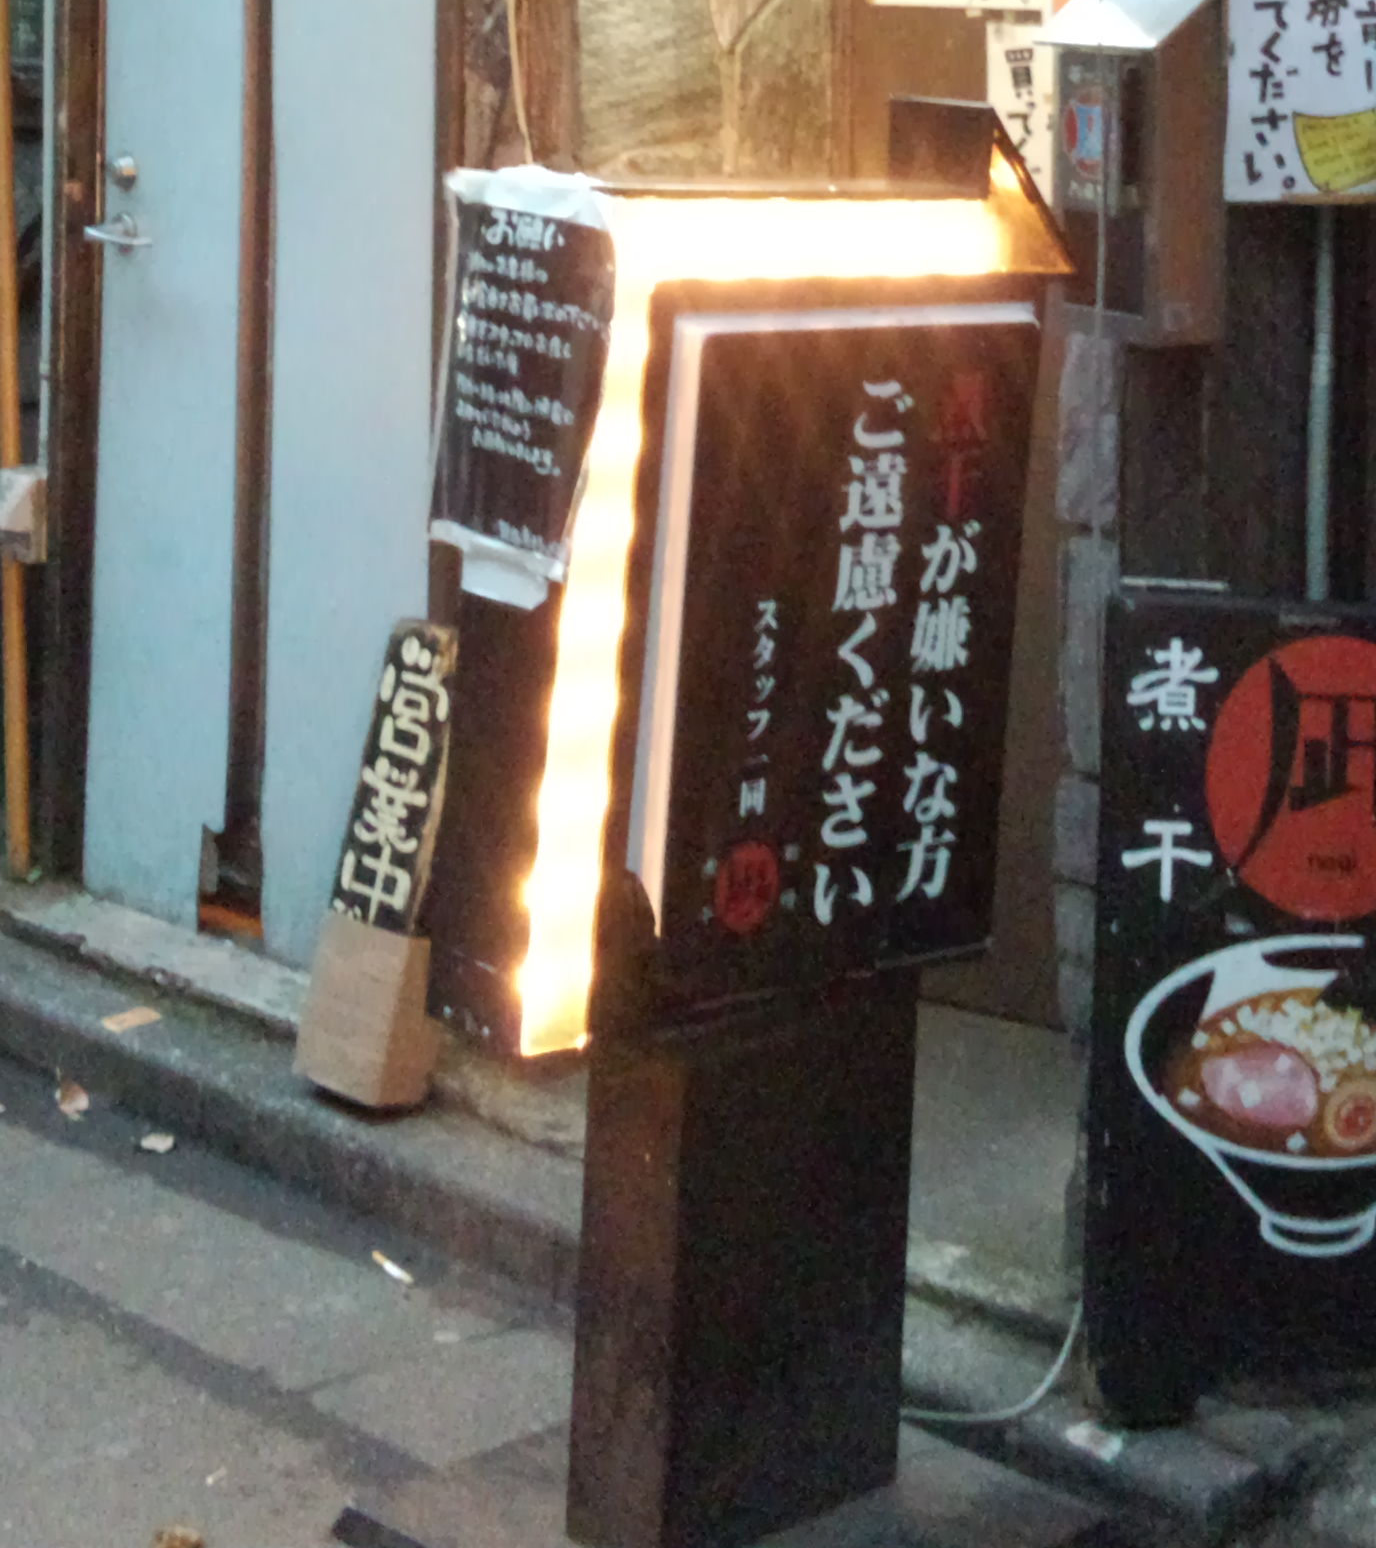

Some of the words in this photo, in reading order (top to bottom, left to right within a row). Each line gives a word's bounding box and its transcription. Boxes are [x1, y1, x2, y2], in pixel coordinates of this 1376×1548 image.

[333, 634, 450, 926] 営業中
[814, 378, 915, 927] ご遠慮ください
